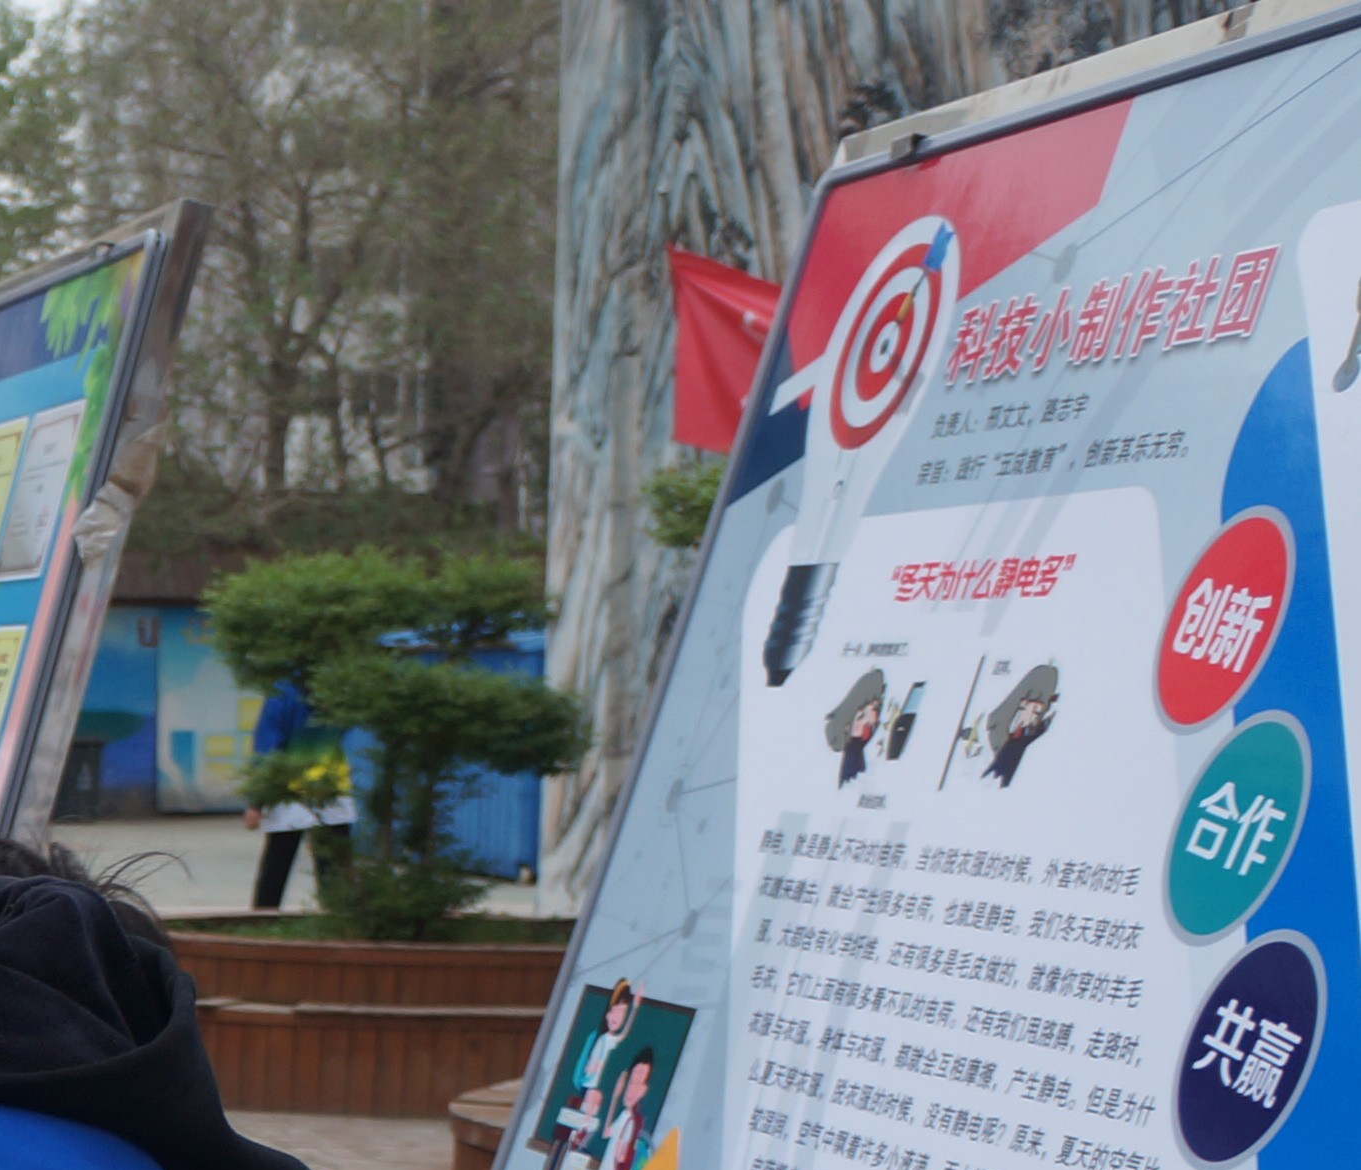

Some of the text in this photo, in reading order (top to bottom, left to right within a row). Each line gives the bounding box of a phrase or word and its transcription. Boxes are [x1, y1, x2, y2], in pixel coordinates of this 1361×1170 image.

[946, 244, 1280, 386] 科技小制作社团
[1172, 577, 1270, 673] 创新
[1186, 782, 1285, 877] 合作
[1192, 998, 1301, 1108] 共赢
